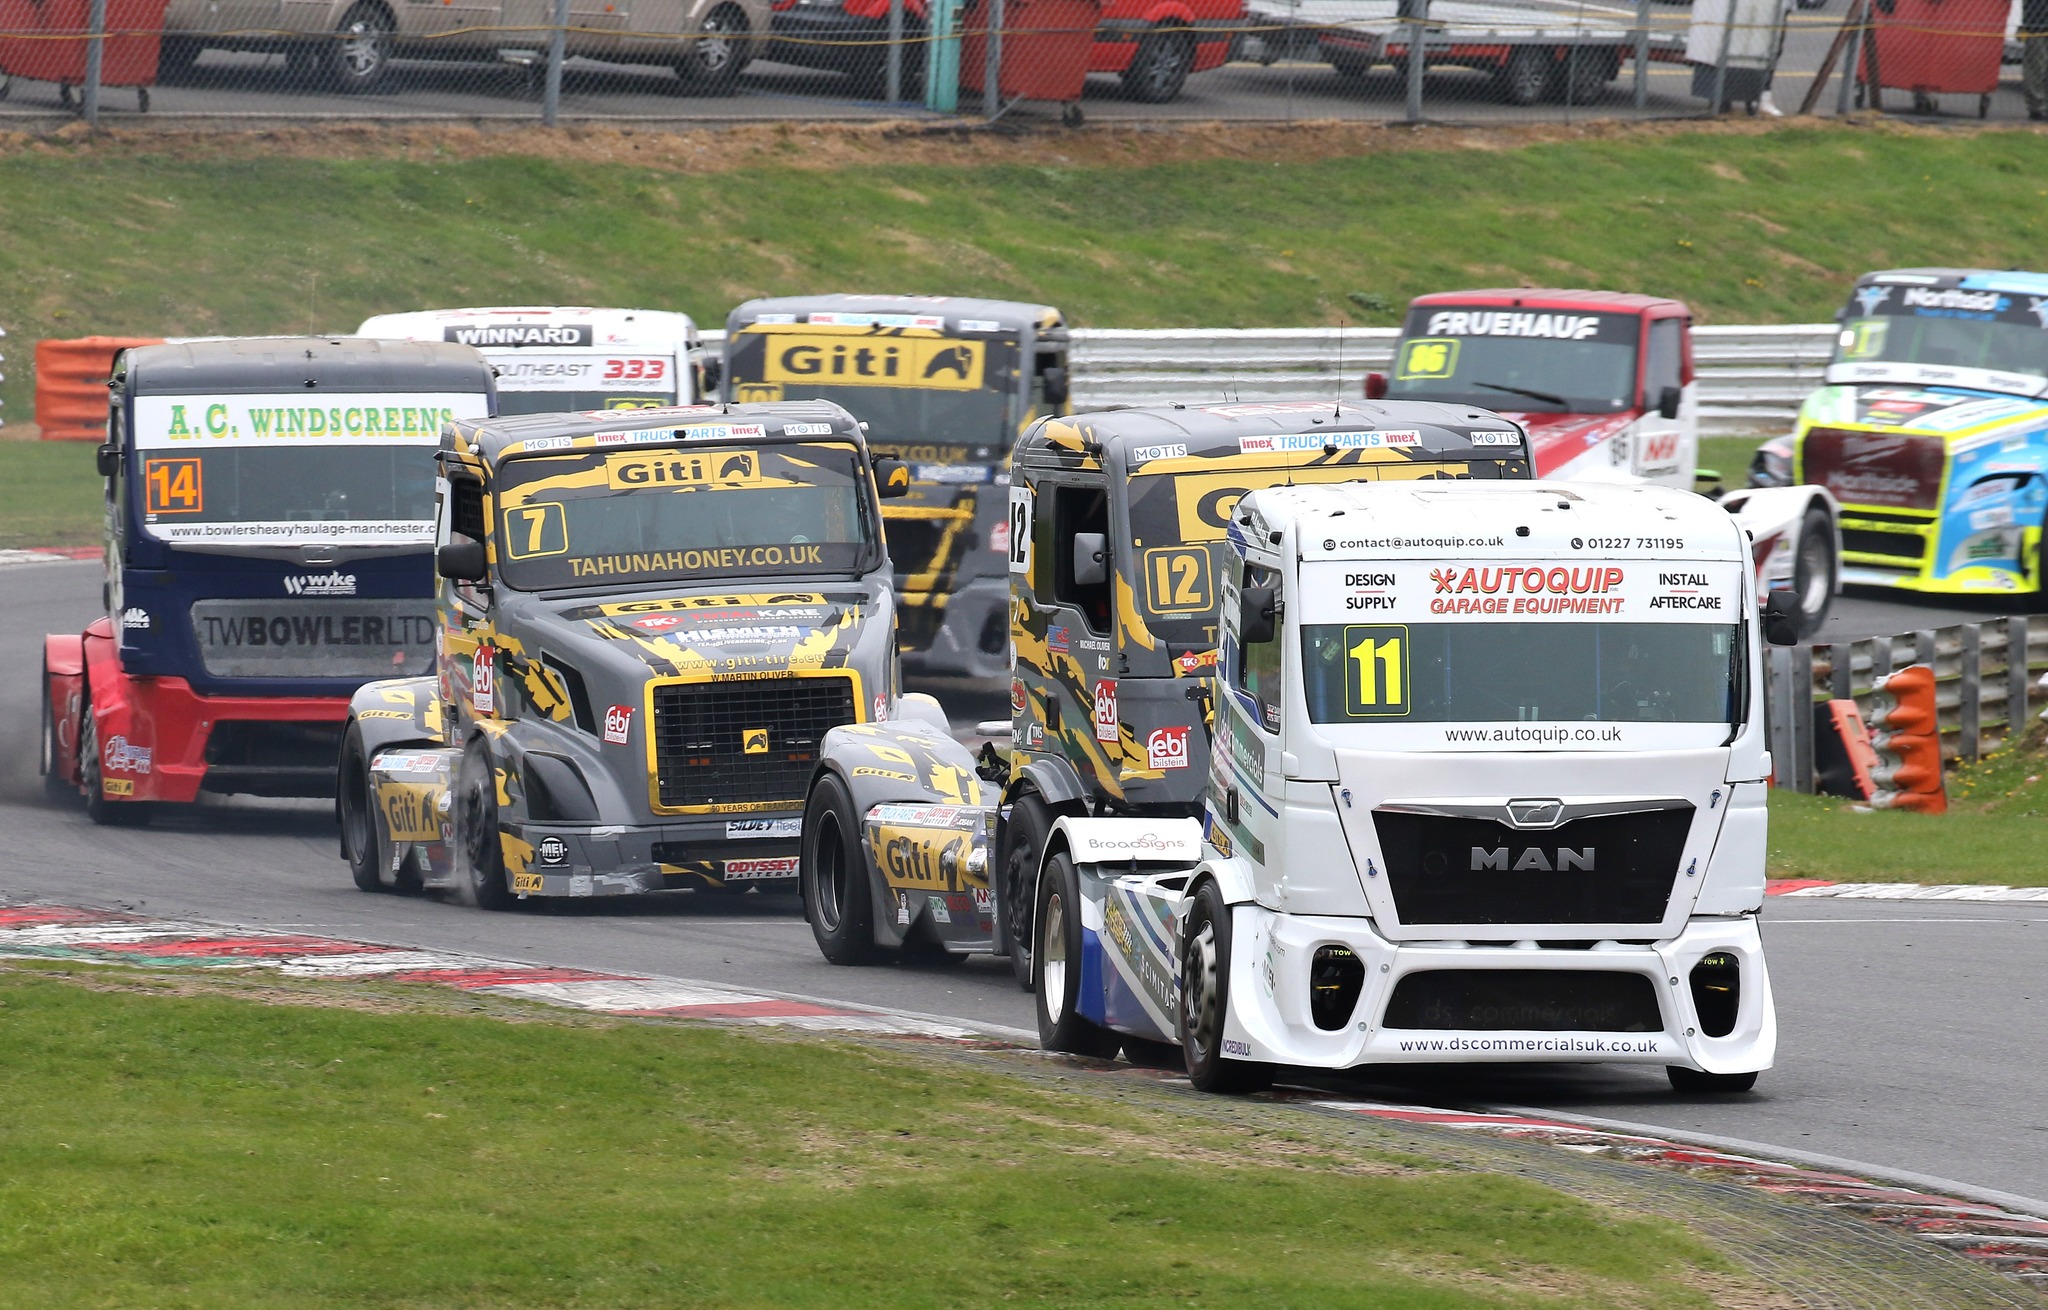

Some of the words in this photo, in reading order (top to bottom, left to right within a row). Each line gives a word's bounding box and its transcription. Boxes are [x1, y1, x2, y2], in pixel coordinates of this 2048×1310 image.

[1427, 311, 1600, 340] FRUEHAUF
[456, 328, 581, 345] WINNARD
[781, 344, 899, 376] Giti
[1408, 344, 1447, 373] 86
[604, 360, 665, 379] 333
[168, 404, 201, 440] A.
[206, 403, 238, 440] C.
[248, 407, 452, 438] WINDSCREENS
[597, 432, 626, 444] imex
[731, 426, 761, 436] imex
[1242, 438, 1273, 450] imex
[1279, 435, 1327, 449] TRUCK
[1333, 433, 1380, 447] PARTS
[1385, 432, 1415, 444] imex
[617, 459, 703, 484] Giti
[150, 465, 198, 508] 14
[521, 508, 546, 552] 7
[1010, 502, 1026, 564] 12
[1340, 536, 1504, 550] contact@autoquip.co.uk
[1588, 538, 1631, 549] 01227
[1636, 538, 1684, 549] 731195
[568, 546, 823, 577] TAHUNAHONEY.CO.UK
[306, 569, 357, 590] wyke
[1156, 554, 1201, 606] 12
[1345, 573, 1396, 586] DESIGN
[1455, 567, 1624, 595] AUTOQUIP
[1659, 573, 1709, 586] INSTALL
[617, 597, 742, 612] Giti
[1346, 596, 1397, 610] SUPPLY
[1430, 598, 1509, 614] GARAGE
[1513, 598, 1625, 614] EQUIPMENT
[1650, 596, 1721, 609] AFTERCARE
[473, 649, 493, 692] febi
[676, 653, 825, 670] www.giti-tire.eu
[711, 672, 757, 683] W.MARTIN
[759, 670, 794, 680] OLIVER
[1349, 637, 1402, 706] 11
[1095, 682, 1117, 724] febi
[605, 705, 632, 732] febi
[1098, 727, 1116, 740] bilstein
[1445, 726, 1622, 744] www.autoquip.co.uk
[1147, 729, 1187, 757] febi
[1153, 757, 1185, 767] bilstein
[856, 768, 892, 777] Giti
[389, 790, 417, 833] Giti
[722, 804, 748, 812] YEARS
[750, 803, 760, 811] OF
[541, 843, 564, 854] MEI
[727, 859, 799, 873] ODYSSEY
[887, 836, 932, 880] Giti
[1469, 846, 1596, 873] MAN
[515, 877, 530, 887] Giti
[1141, 954, 1175, 1010] SCIMITAR
[1400, 1037, 1658, 1053] www.dscommercialsuk.co.uk
